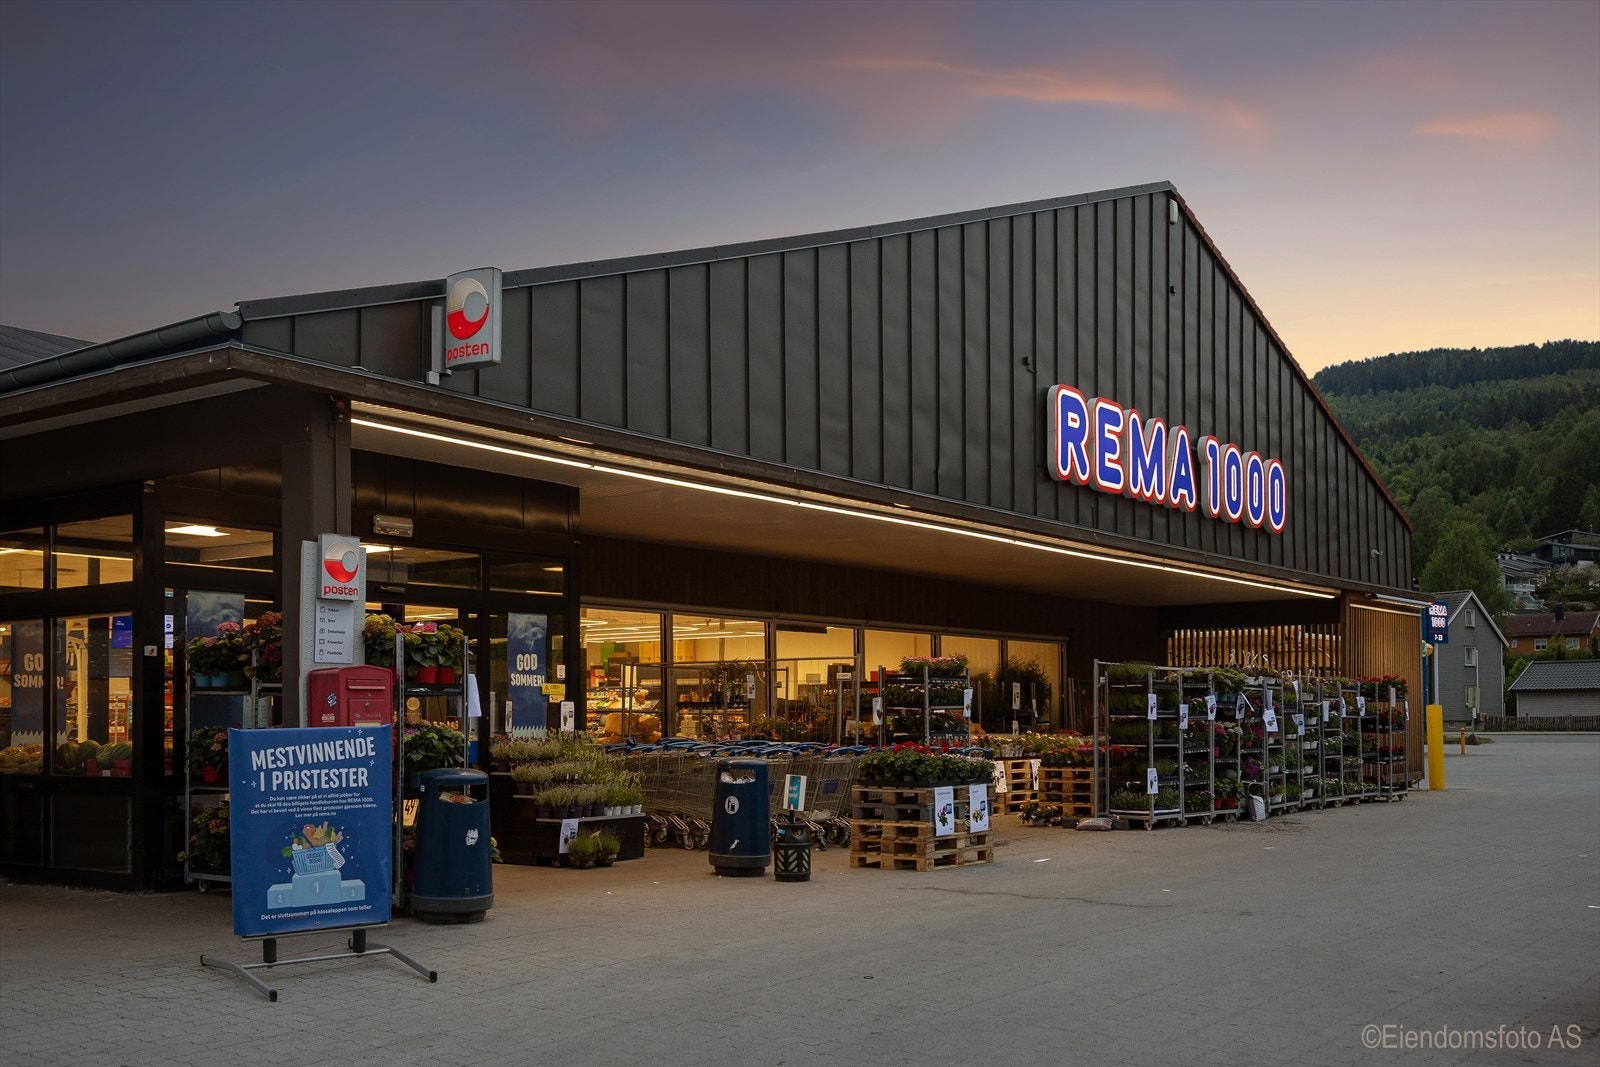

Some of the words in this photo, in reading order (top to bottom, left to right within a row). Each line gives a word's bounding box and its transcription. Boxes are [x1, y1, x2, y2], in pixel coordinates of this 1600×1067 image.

[446, 342, 489, 363] posten
[1048, 384, 1198, 513] REMA
[1198, 435, 1287, 534] 1000
[323, 585, 359, 596] posten
[1429, 604, 1448, 616] REMA
[1431, 616, 1446, 628] 1000
[516, 653, 538, 671] GOD
[251, 736, 376, 771] MESTVINNENDE
[260, 771, 265, 791] I
[272, 767, 369, 791] PRISTESTER
[313, 880, 320, 894] 1
[350, 889, 356, 898] 3
[277, 894, 283, 903] 2
